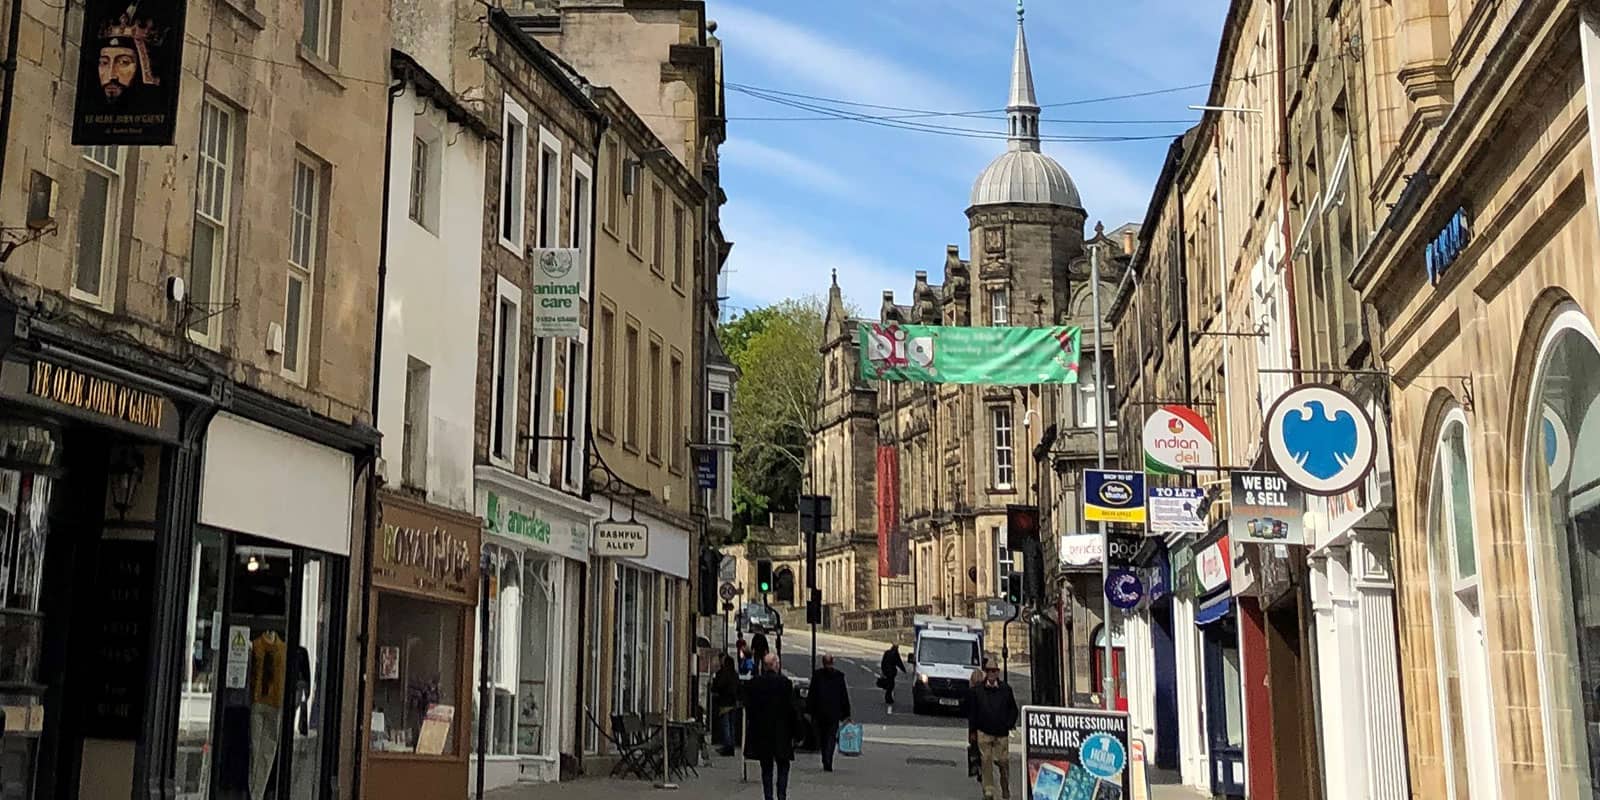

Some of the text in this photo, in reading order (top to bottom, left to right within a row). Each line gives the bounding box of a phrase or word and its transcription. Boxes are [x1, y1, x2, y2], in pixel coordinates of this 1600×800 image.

[533, 281, 580, 295] animal
[541, 298, 572, 308] care
[33, 360, 163, 429] YE OLDE JOHN O'GAUNT
[1154, 436, 1199, 449] indian
[1175, 450, 1200, 463] deli
[1241, 476, 1288, 492] WE BUY
[1156, 488, 1197, 498] TO LET
[1245, 491, 1288, 506] & SELL
[600, 530, 643, 540] BASHFUL
[607, 542, 635, 550] ALLEY
[1028, 713, 1126, 732] FAST, PROFESSIONAL
[1029, 728, 1080, 748] REPAIRS
[1099, 738, 1110, 752] 1
